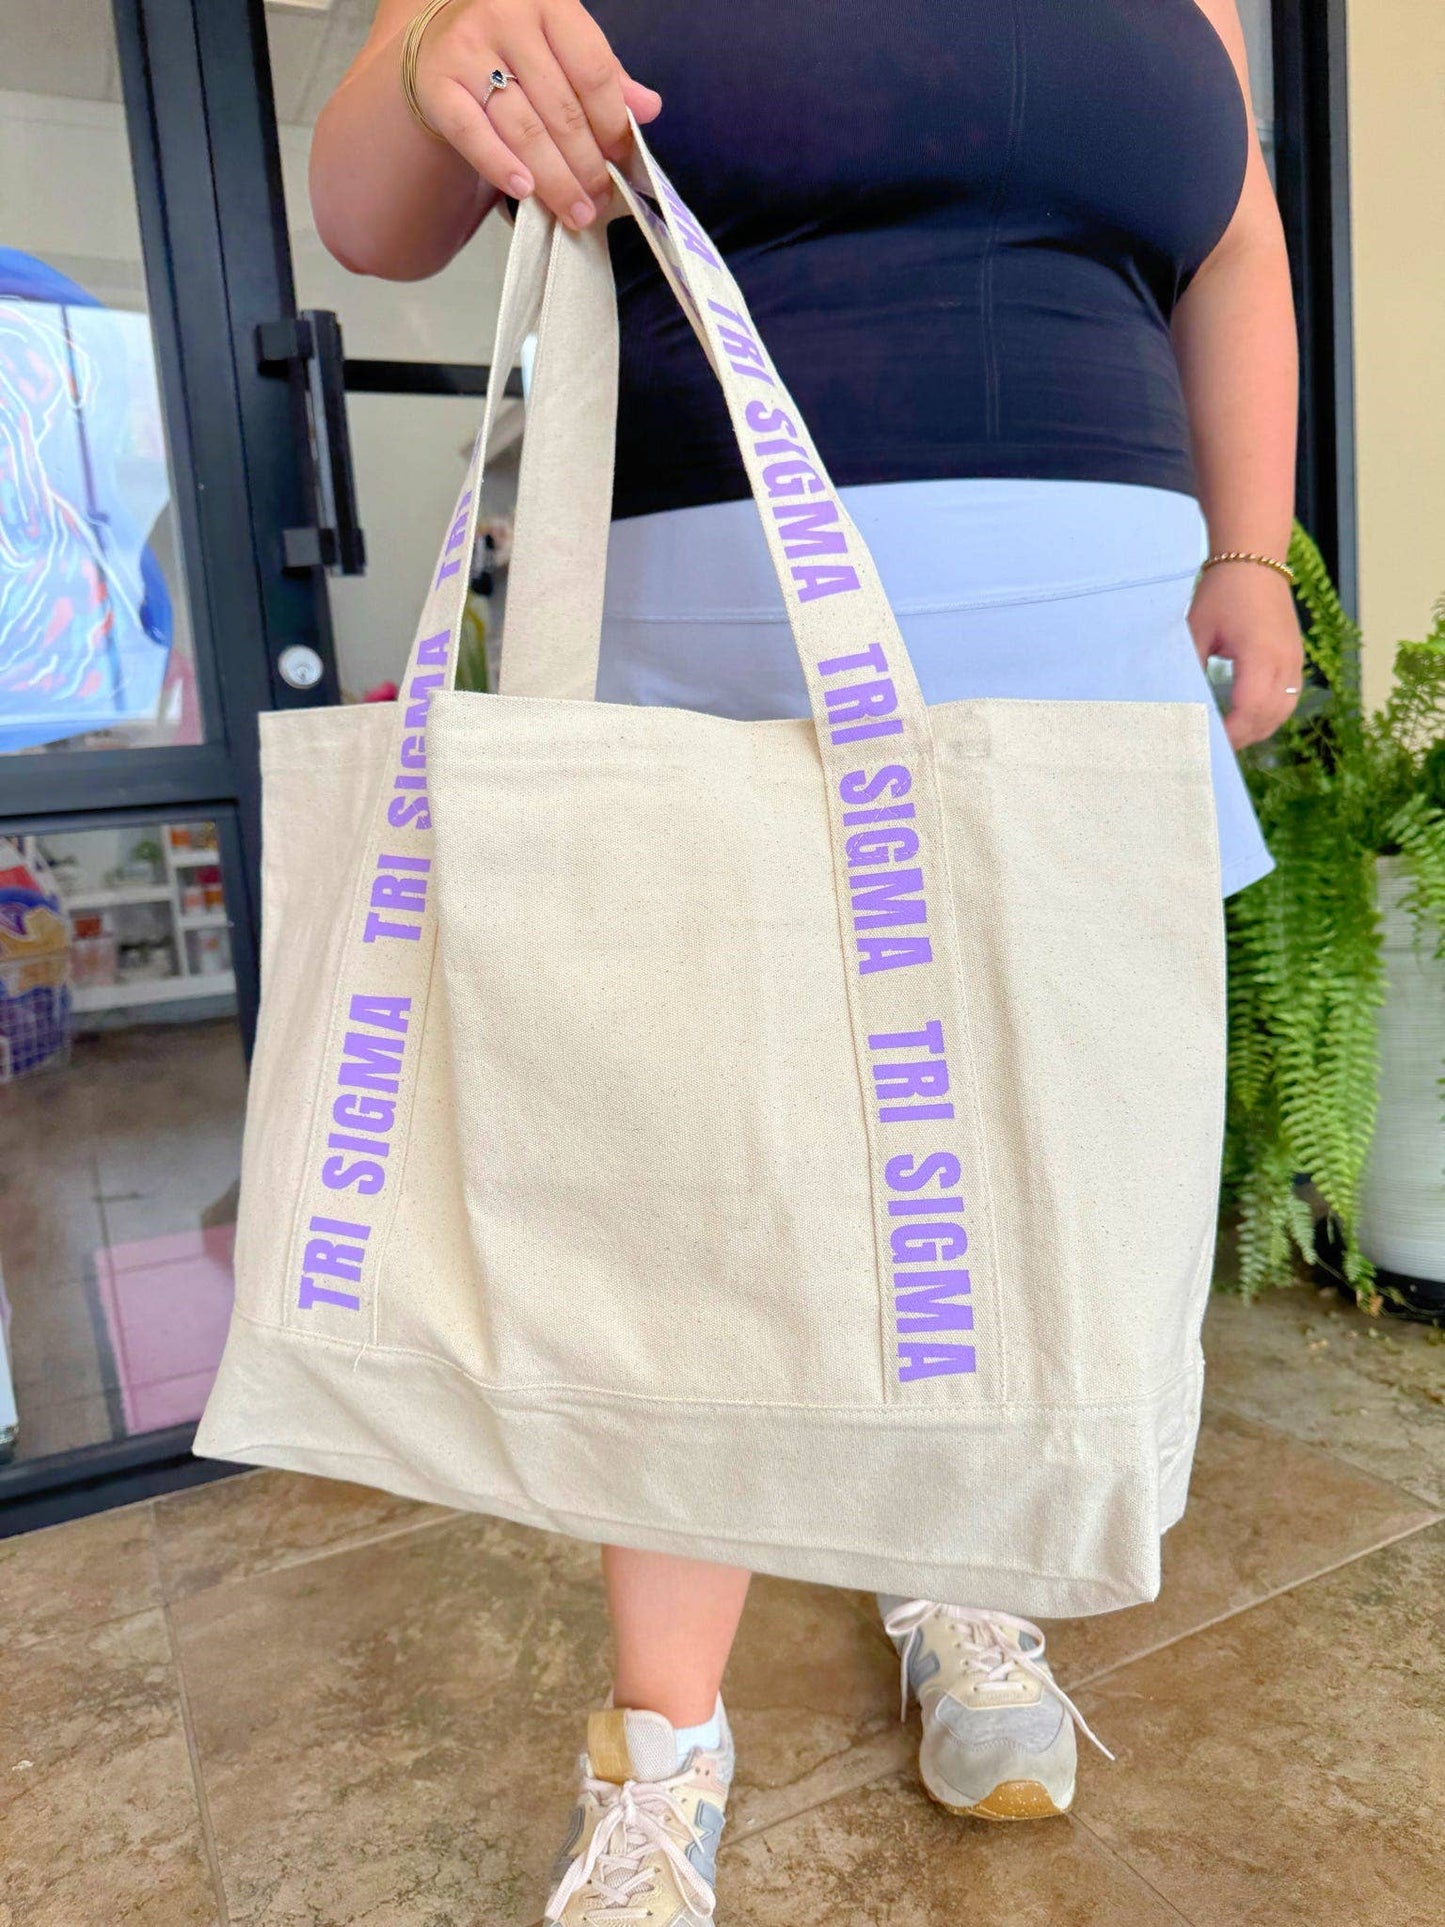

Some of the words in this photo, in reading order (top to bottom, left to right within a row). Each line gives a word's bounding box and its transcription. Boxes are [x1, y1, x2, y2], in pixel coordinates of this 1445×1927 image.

[707, 298, 775, 387] TRI
[435, 489, 472, 591] TRI
[745, 400, 861, 603] SIGMA
[388, 629, 452, 831] SIGMA
[817, 642, 904, 746] TRI
[363, 854, 432, 944] TRI
[839, 764, 933, 975] SIGMA
[321, 994, 412, 1196] SIGMA
[867, 1020, 955, 1123] TRI
[298, 1216, 372, 1310] TRI
[884, 1151, 976, 1383] SIGMA
